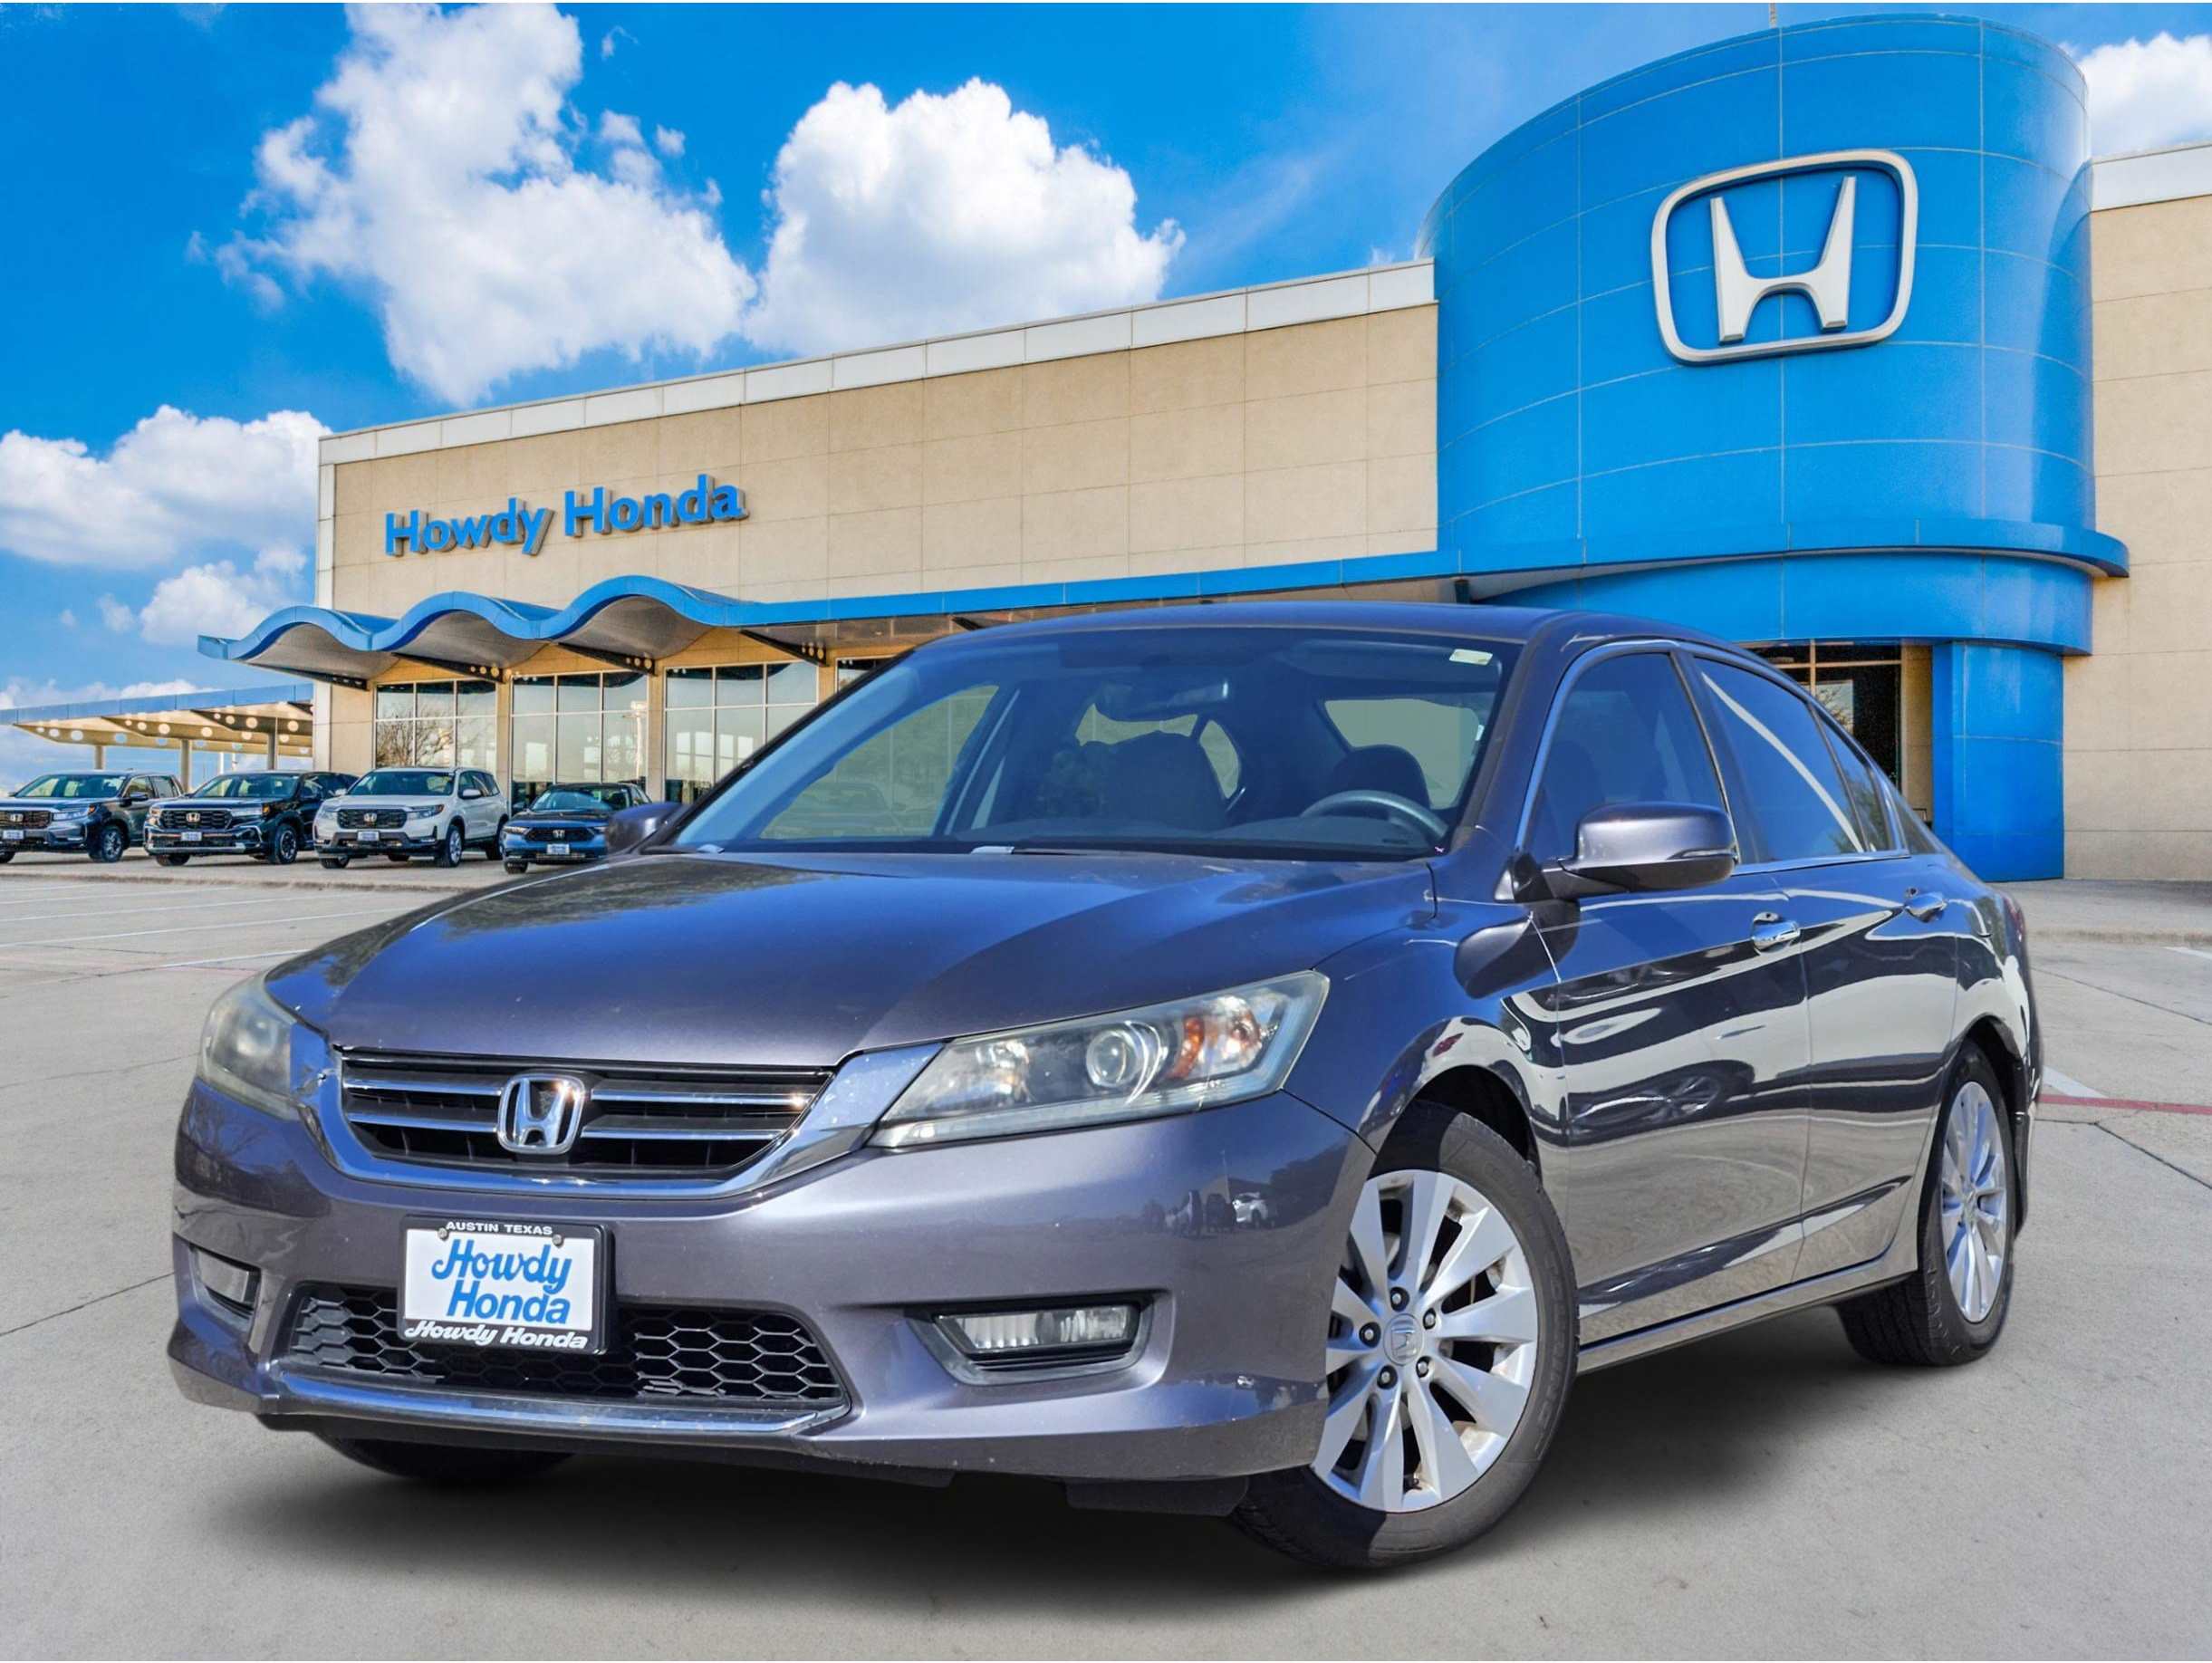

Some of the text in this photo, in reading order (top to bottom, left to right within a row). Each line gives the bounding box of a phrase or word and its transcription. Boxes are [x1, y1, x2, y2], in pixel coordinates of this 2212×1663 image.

[385, 474, 748, 556] Howdy Honda
[446, 1221, 553, 1235] AUSTIN TEXAS
[431, 1238, 572, 1294] Howdy
[447, 1280, 572, 1324] Honda
[404, 1320, 588, 1350] Howdy Honda
